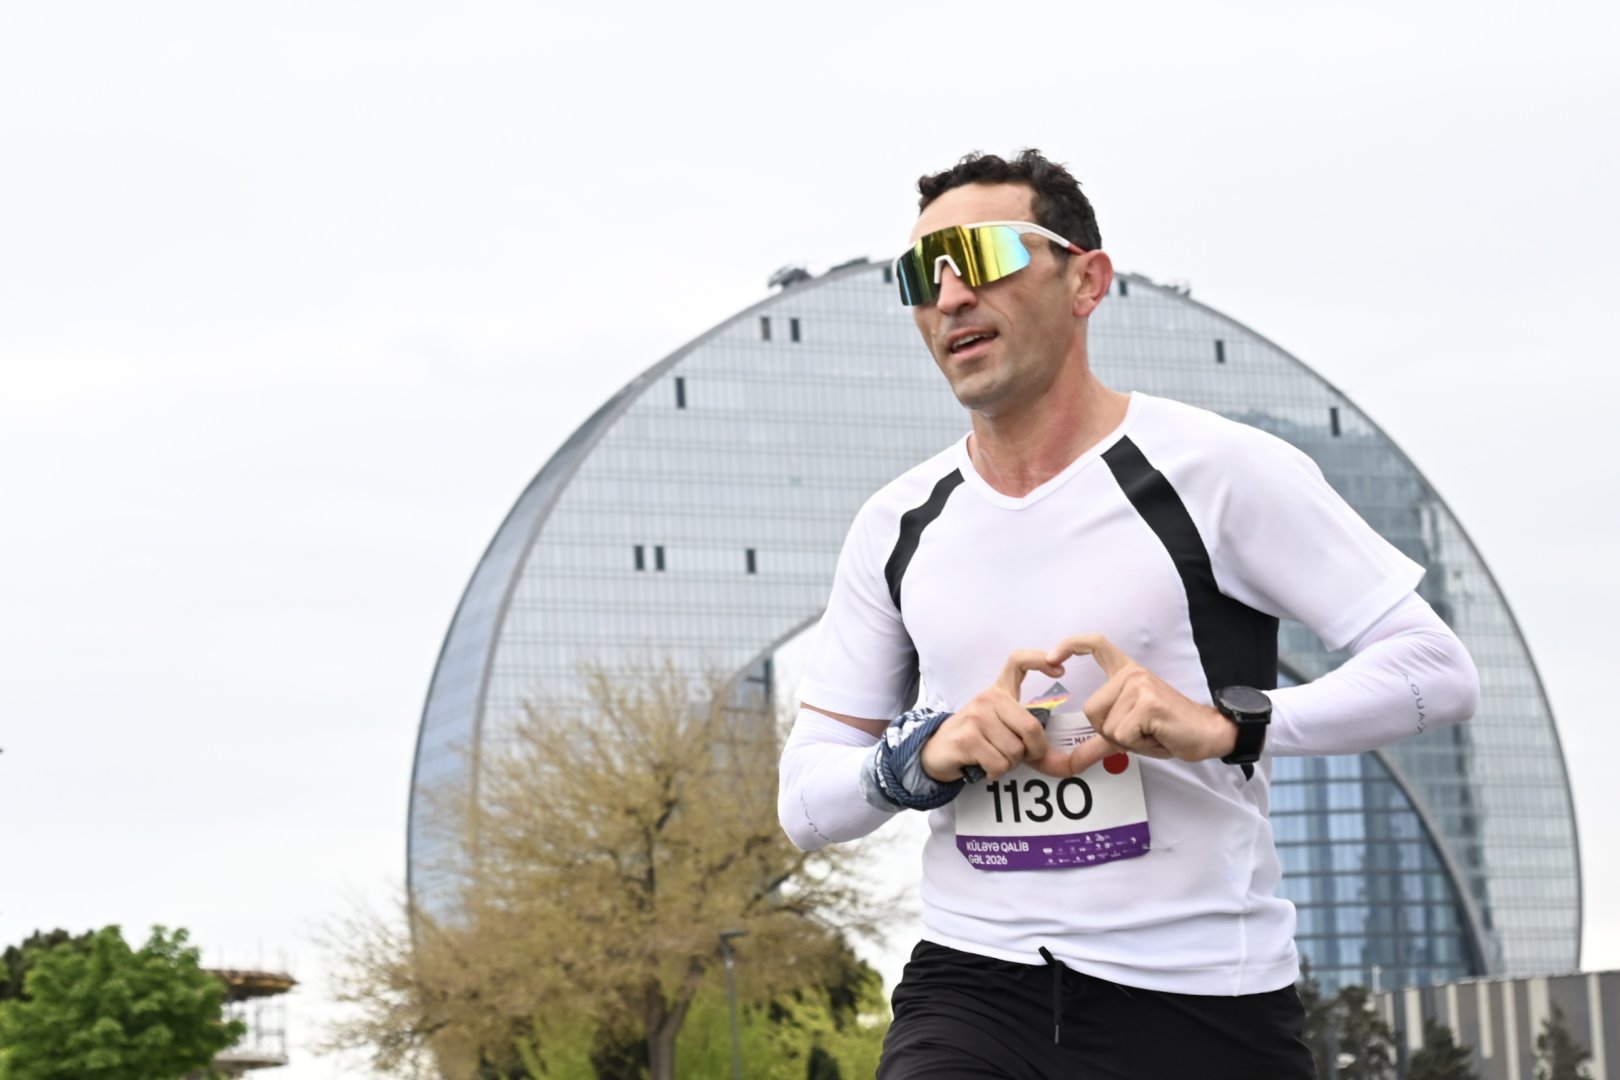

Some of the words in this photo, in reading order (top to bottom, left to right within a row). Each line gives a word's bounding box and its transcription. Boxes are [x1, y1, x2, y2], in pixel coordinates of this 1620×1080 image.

[986, 777, 1093, 823] 1130
[966, 840, 999, 852] KÜLƏYƏ
[1000, 840, 1029, 853] QALİB
[968, 854, 984, 865] GƏL
[985, 854, 1008, 865] 2026
